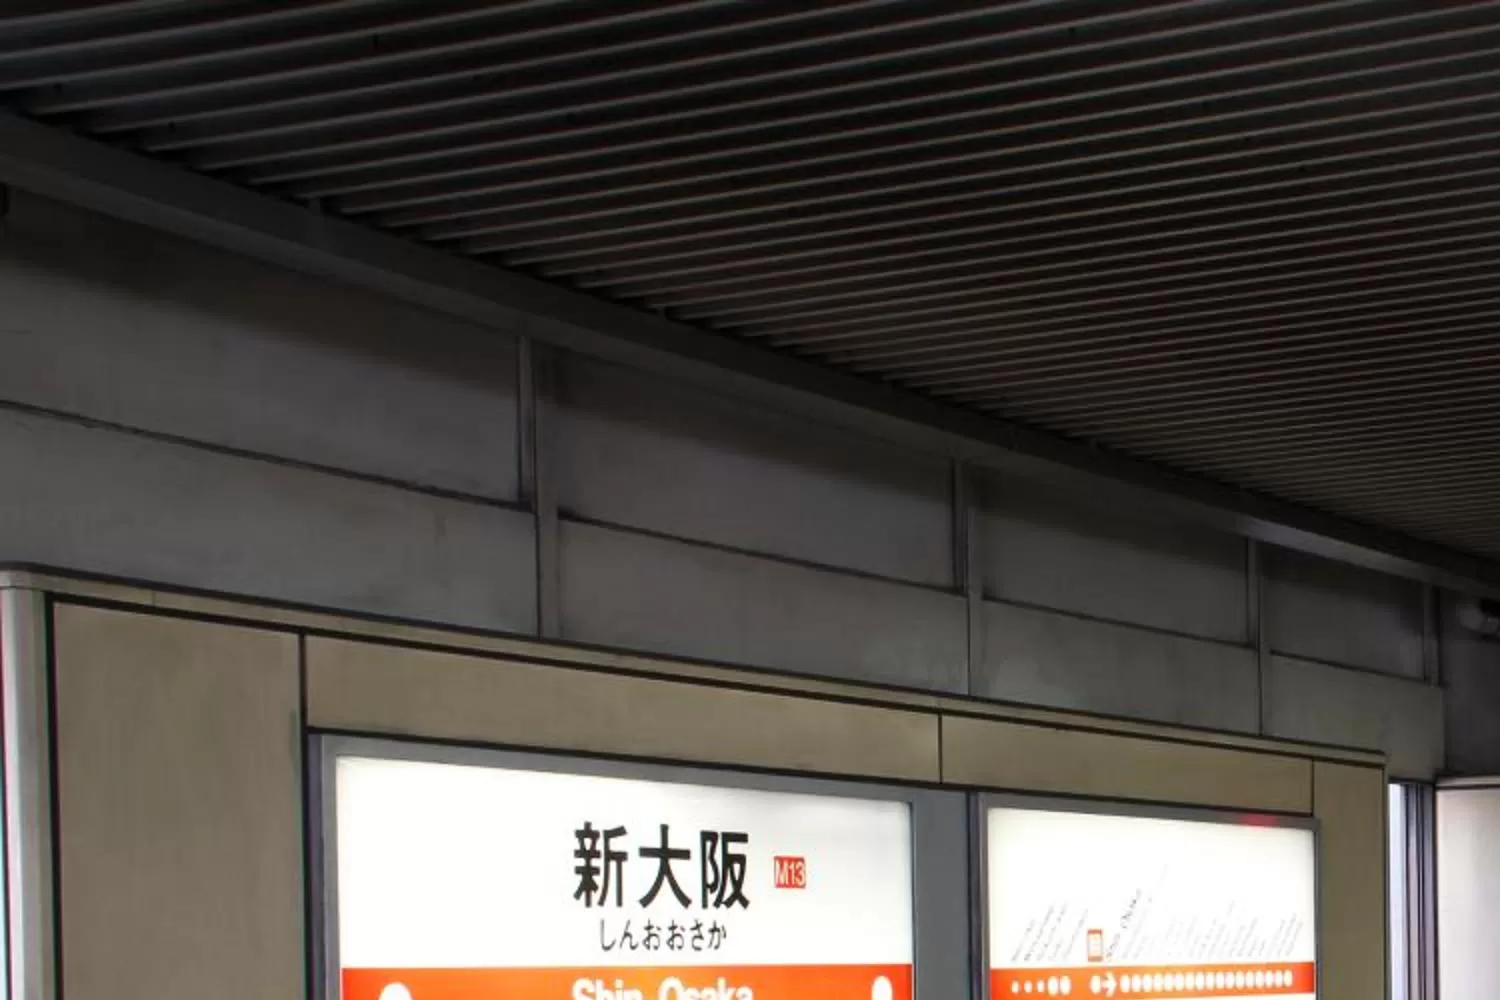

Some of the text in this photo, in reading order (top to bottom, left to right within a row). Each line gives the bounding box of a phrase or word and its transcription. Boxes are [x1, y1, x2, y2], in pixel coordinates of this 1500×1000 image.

[573, 821, 750, 910] 新大阪
[775, 858, 806, 887] M13
[600, 919, 727, 952] しんおおさか
